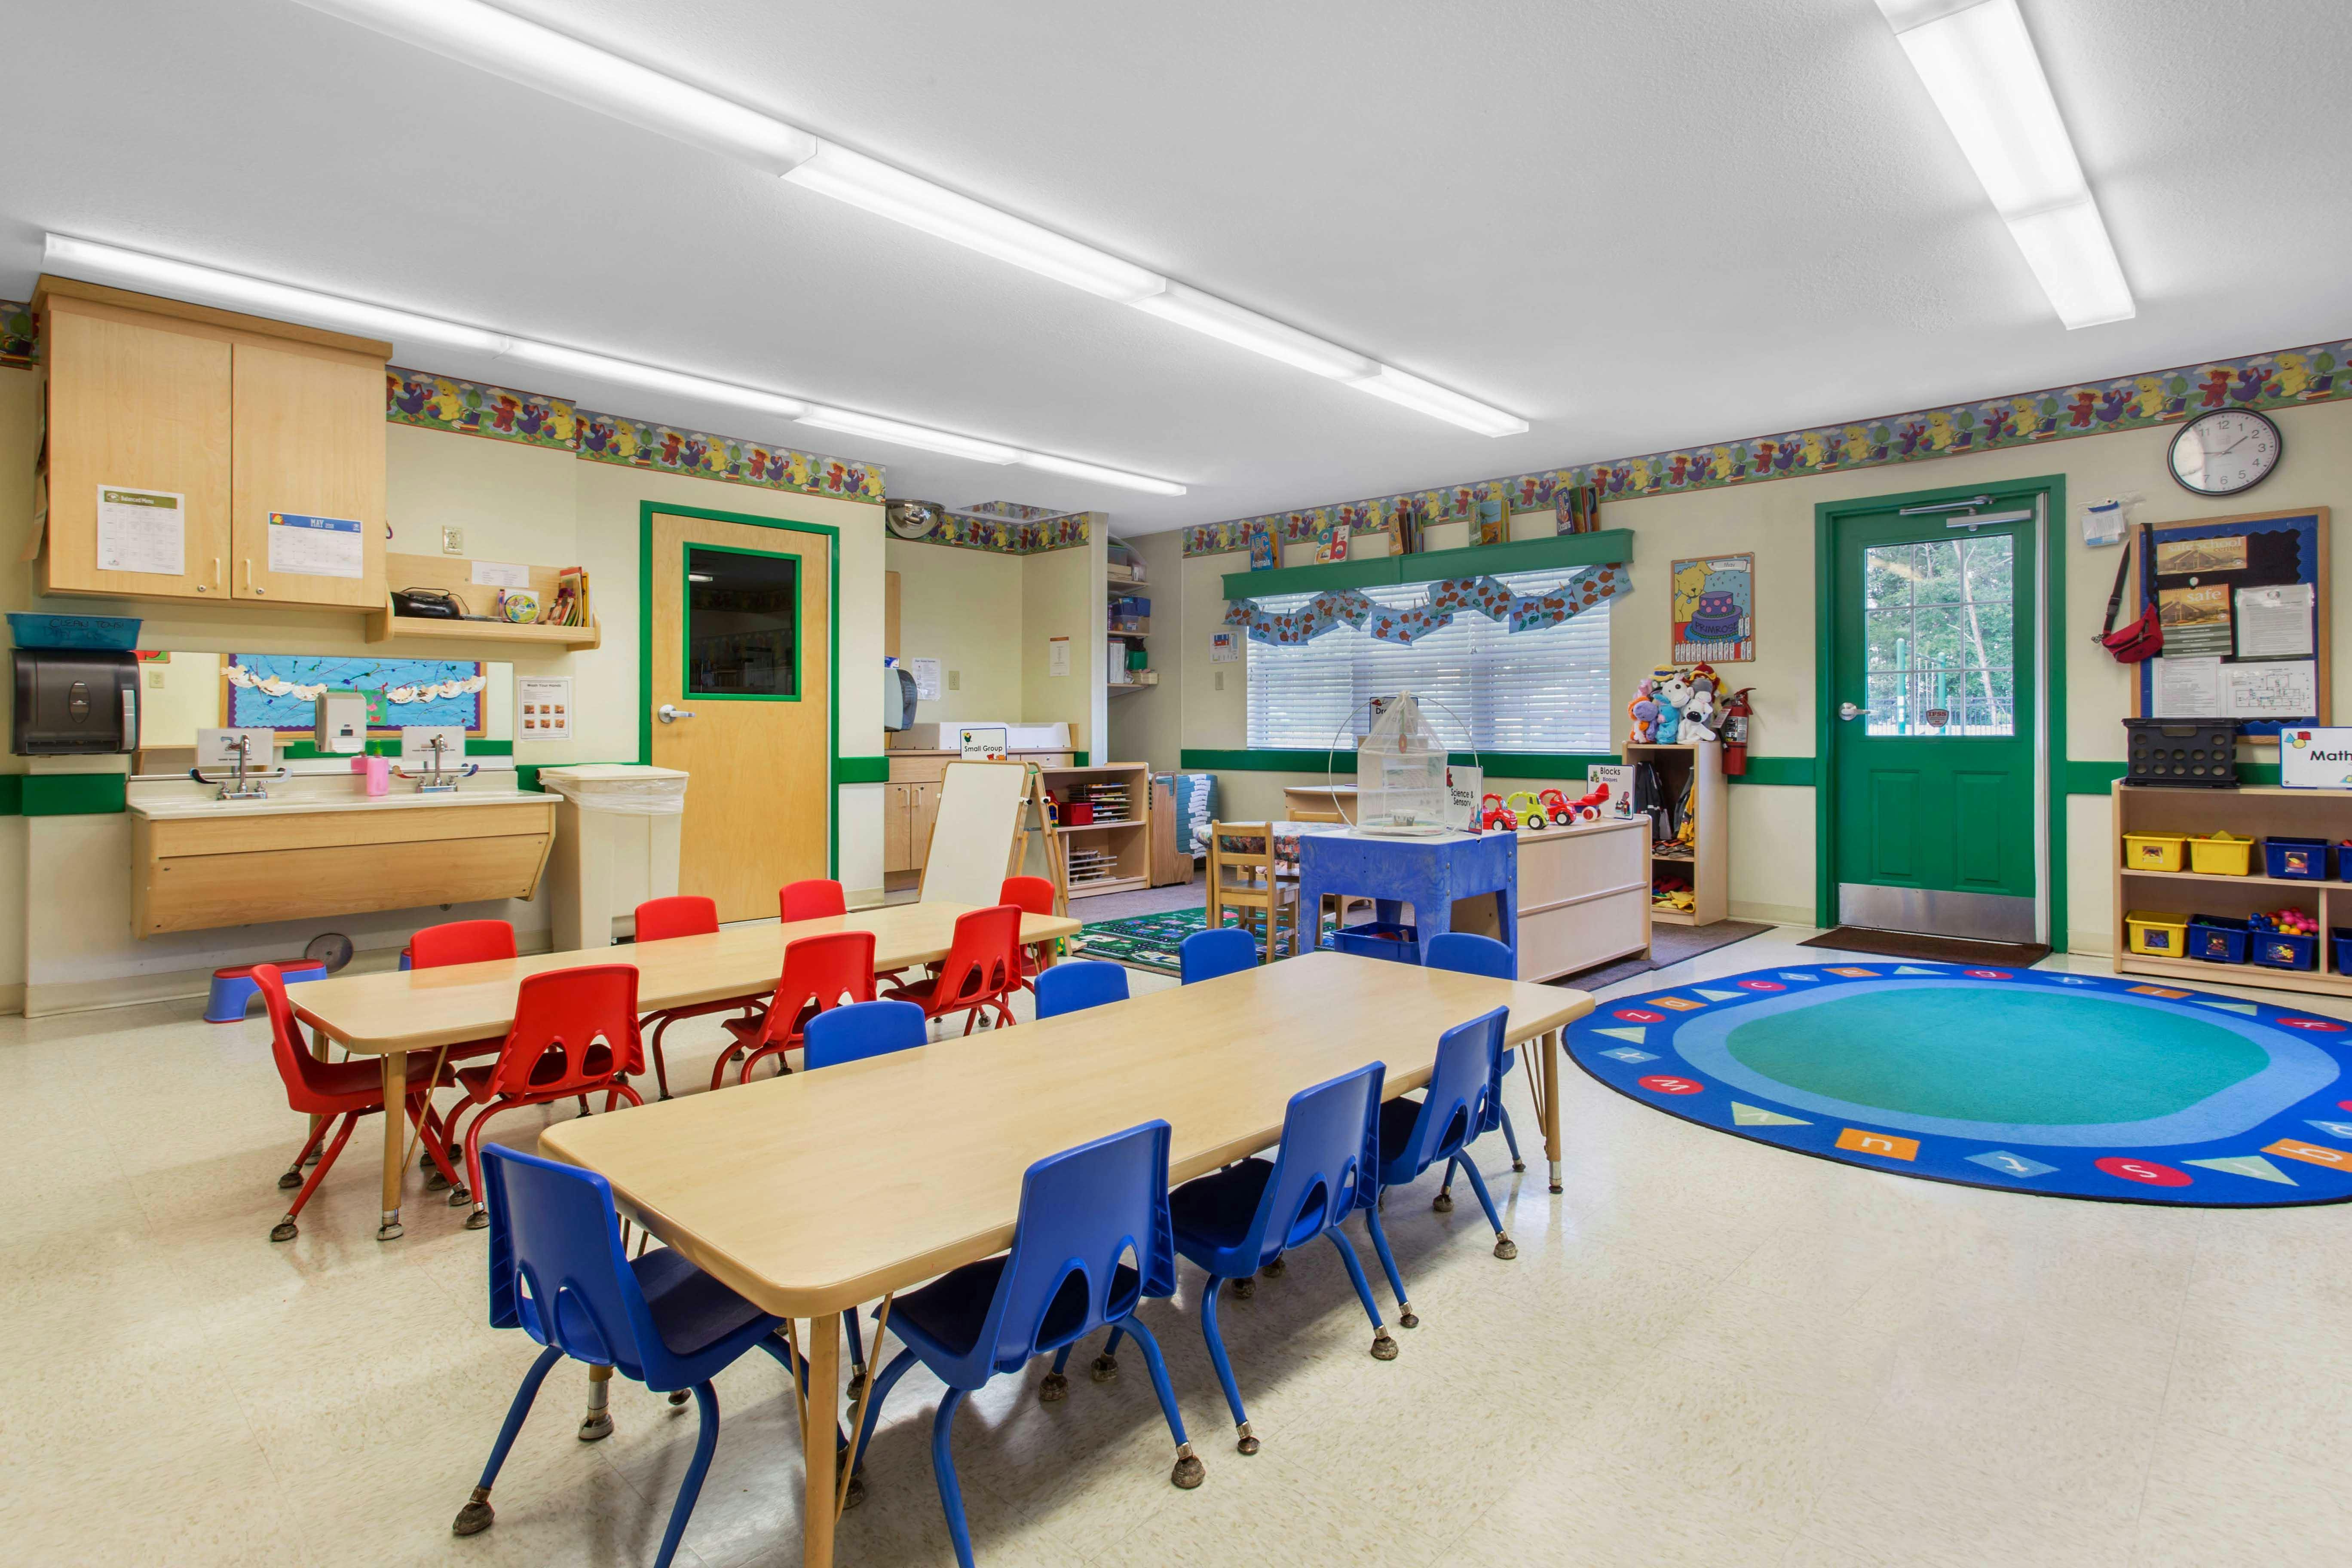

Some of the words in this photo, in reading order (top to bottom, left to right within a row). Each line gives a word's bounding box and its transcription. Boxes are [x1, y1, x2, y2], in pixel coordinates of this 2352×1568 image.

[2217, 420, 2230, 430] 12
[2238, 423, 2243, 432] 1
[2199, 429, 2210, 437] 11
[2251, 430, 2260, 439] 2
[2257, 444, 2266, 452] 3
[2252, 458, 2260, 467] 4
[2203, 475, 2210, 483] 7
[2238, 470, 2246, 479] 5
[2220, 476, 2228, 485] 6
[310, 518, 324, 528] MAY
[2168, 542, 2193, 552] safe
[1252, 558, 1271, 568] Animals
[2187, 588, 2222, 602] safe
[2310, 750, 2352, 761] Math
[1600, 767, 1620, 775] Blocks
[1451, 788, 1469, 798] Science
